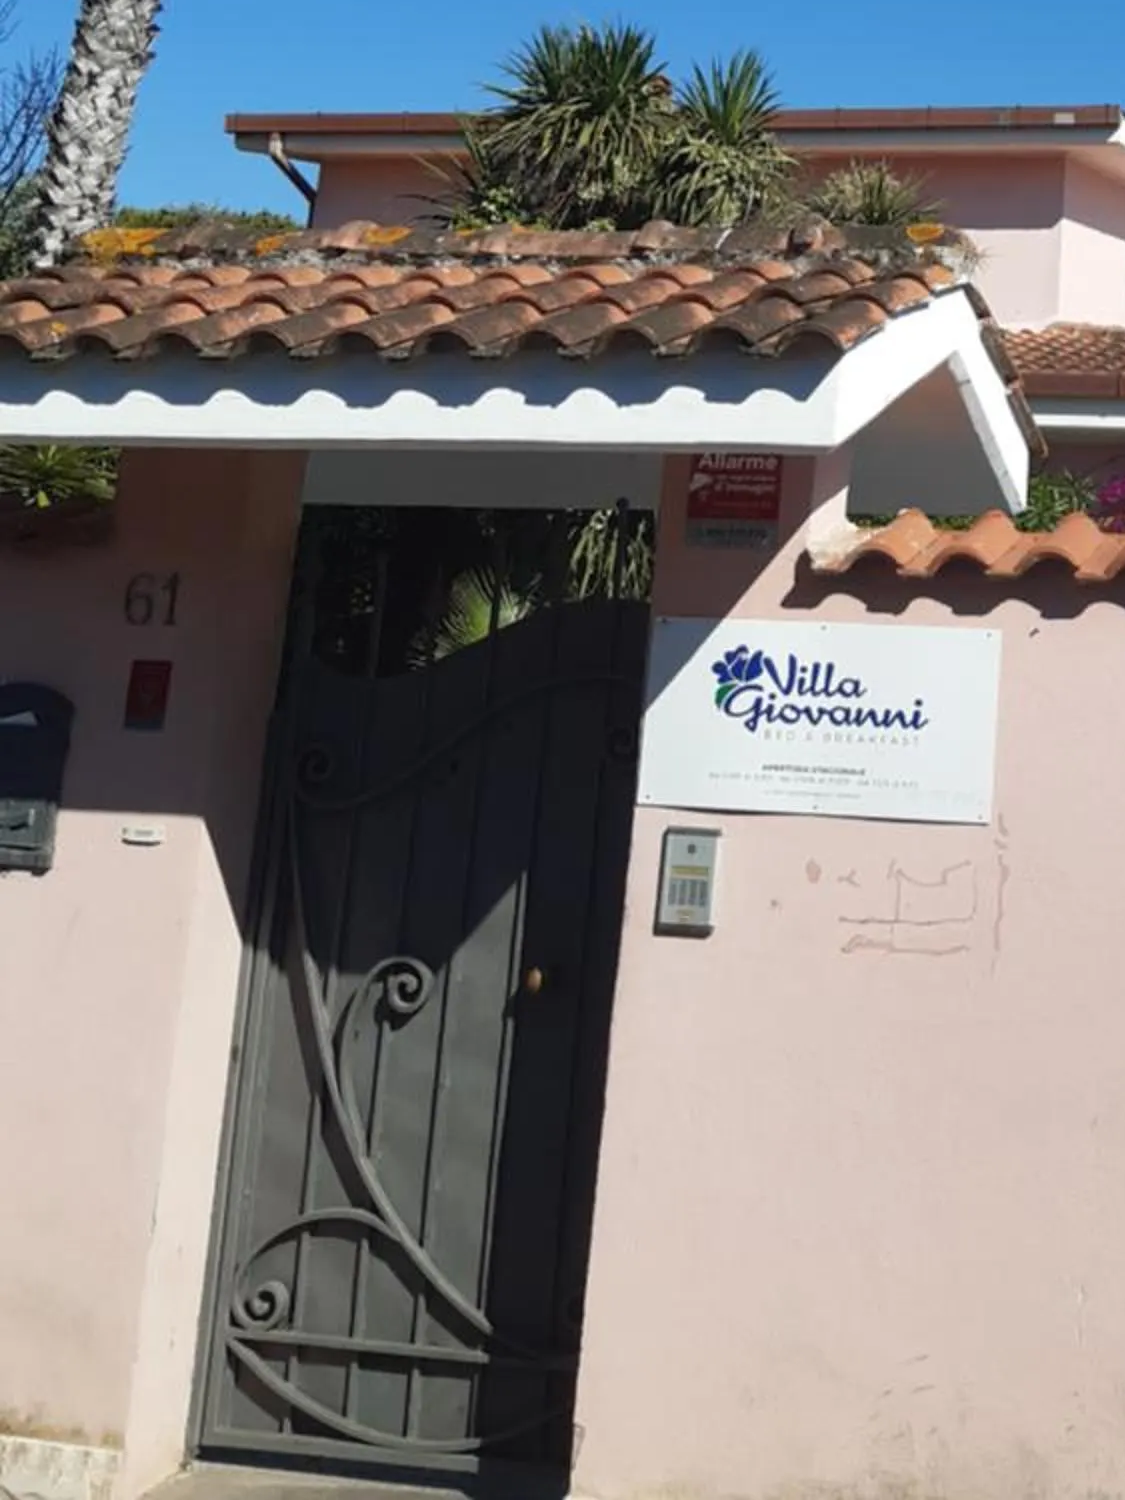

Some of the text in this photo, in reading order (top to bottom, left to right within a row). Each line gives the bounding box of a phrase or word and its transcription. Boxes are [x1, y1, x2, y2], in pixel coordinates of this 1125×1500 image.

[698, 452, 779, 470] Allarme
[123, 571, 181, 627] 61
[763, 653, 867, 697] Villa
[724, 684, 930, 733] Giovanni
